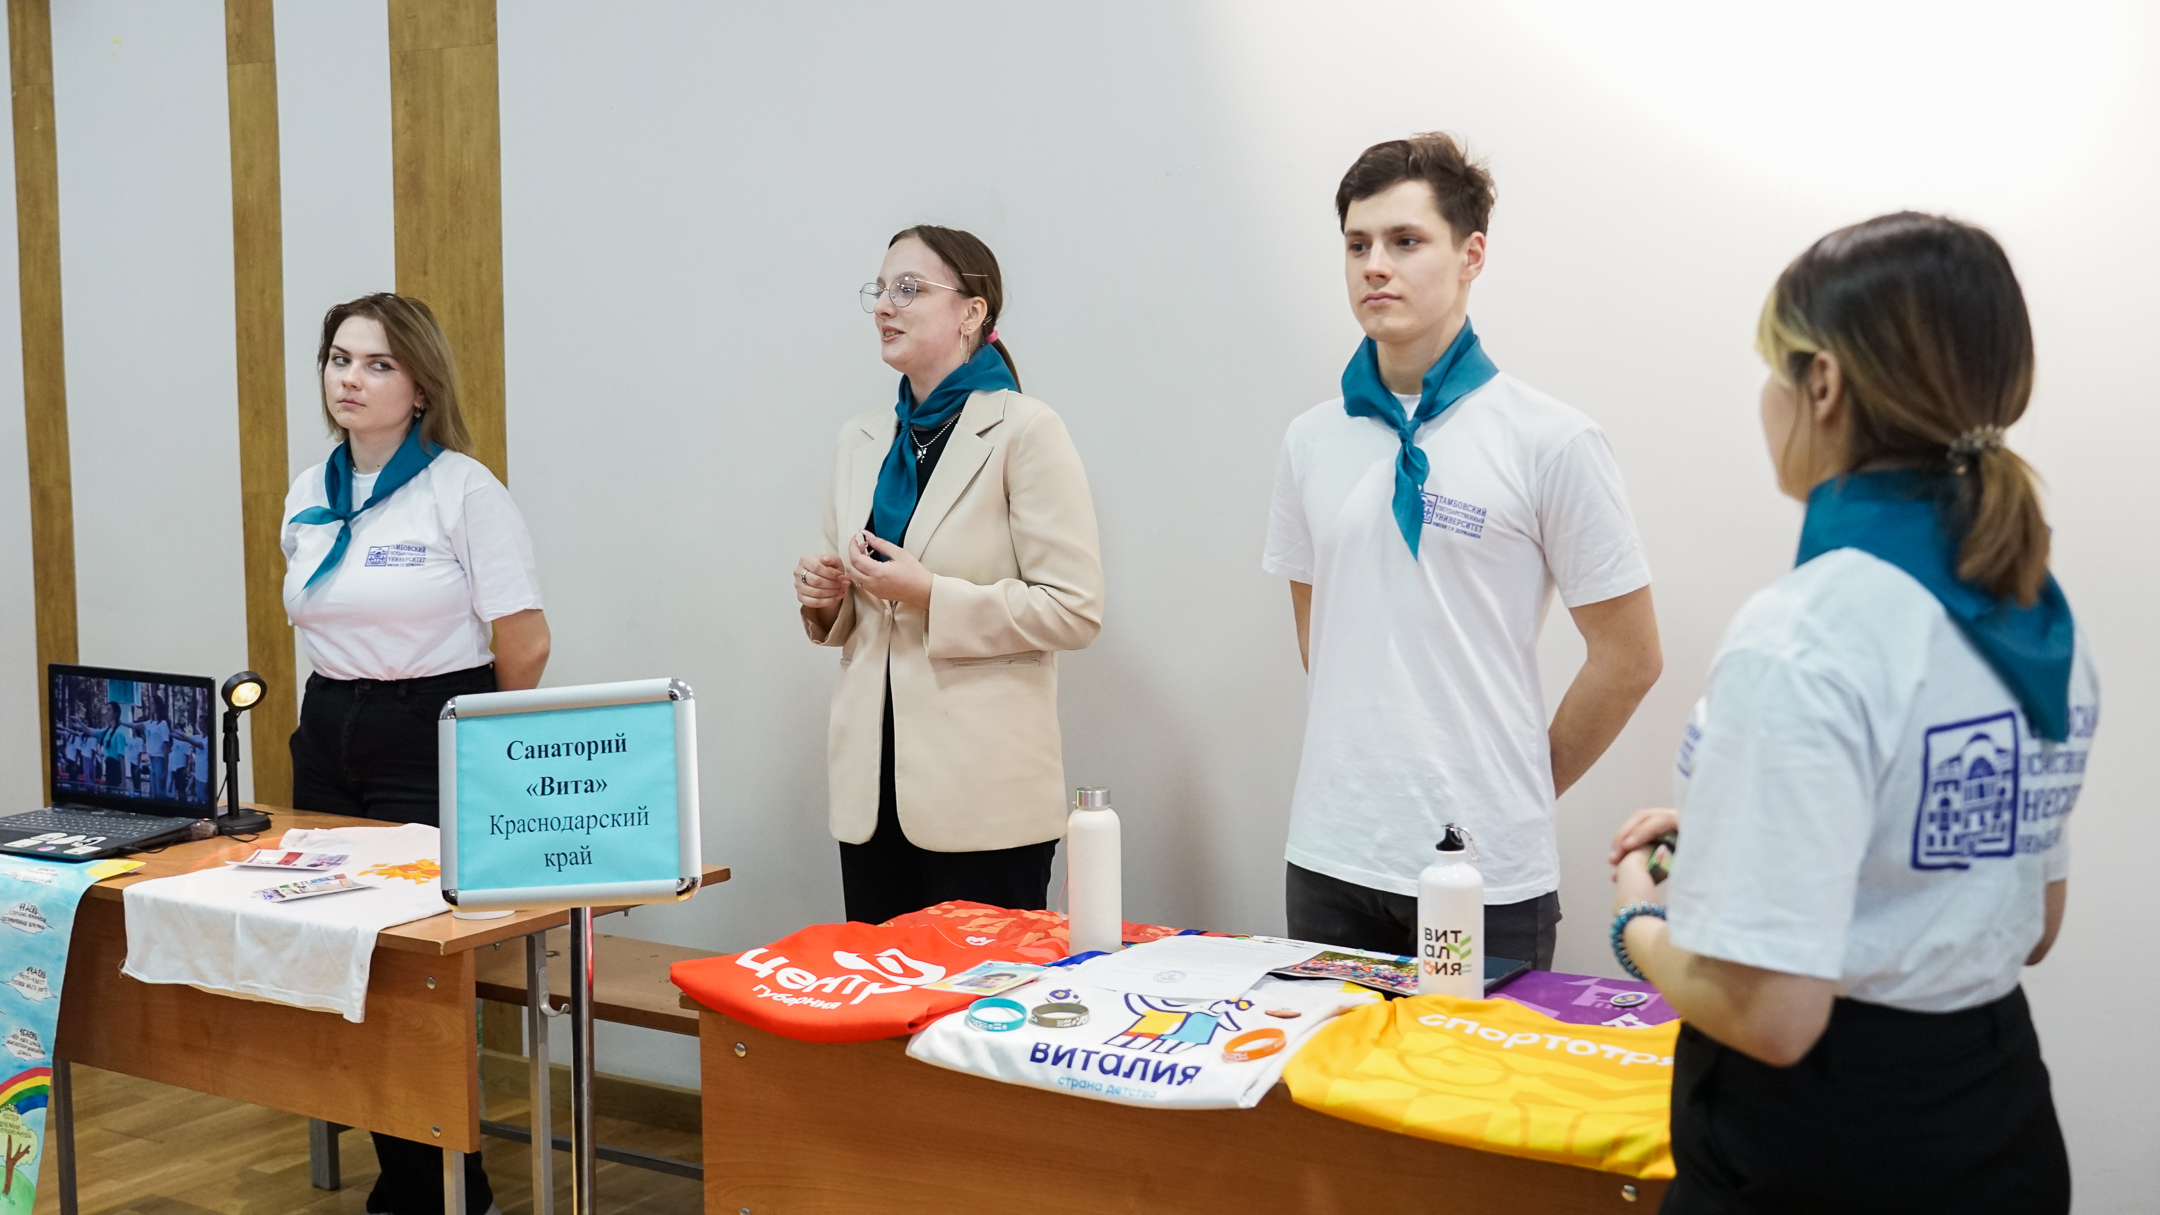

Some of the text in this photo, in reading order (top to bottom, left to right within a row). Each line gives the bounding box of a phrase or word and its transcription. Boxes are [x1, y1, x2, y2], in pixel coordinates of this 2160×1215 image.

[1439, 496, 1487, 517] ТАМБОВСКИЙ
[1434, 512, 1483, 533] УНИВЕРСИТЕТ
[506, 732, 628, 761] Санаторий
[526, 776, 608, 797] «Вита»
[489, 805, 650, 841] Краснодарский
[543, 845, 593, 872] край
[1058, 1076, 1158, 1099] страна детства
